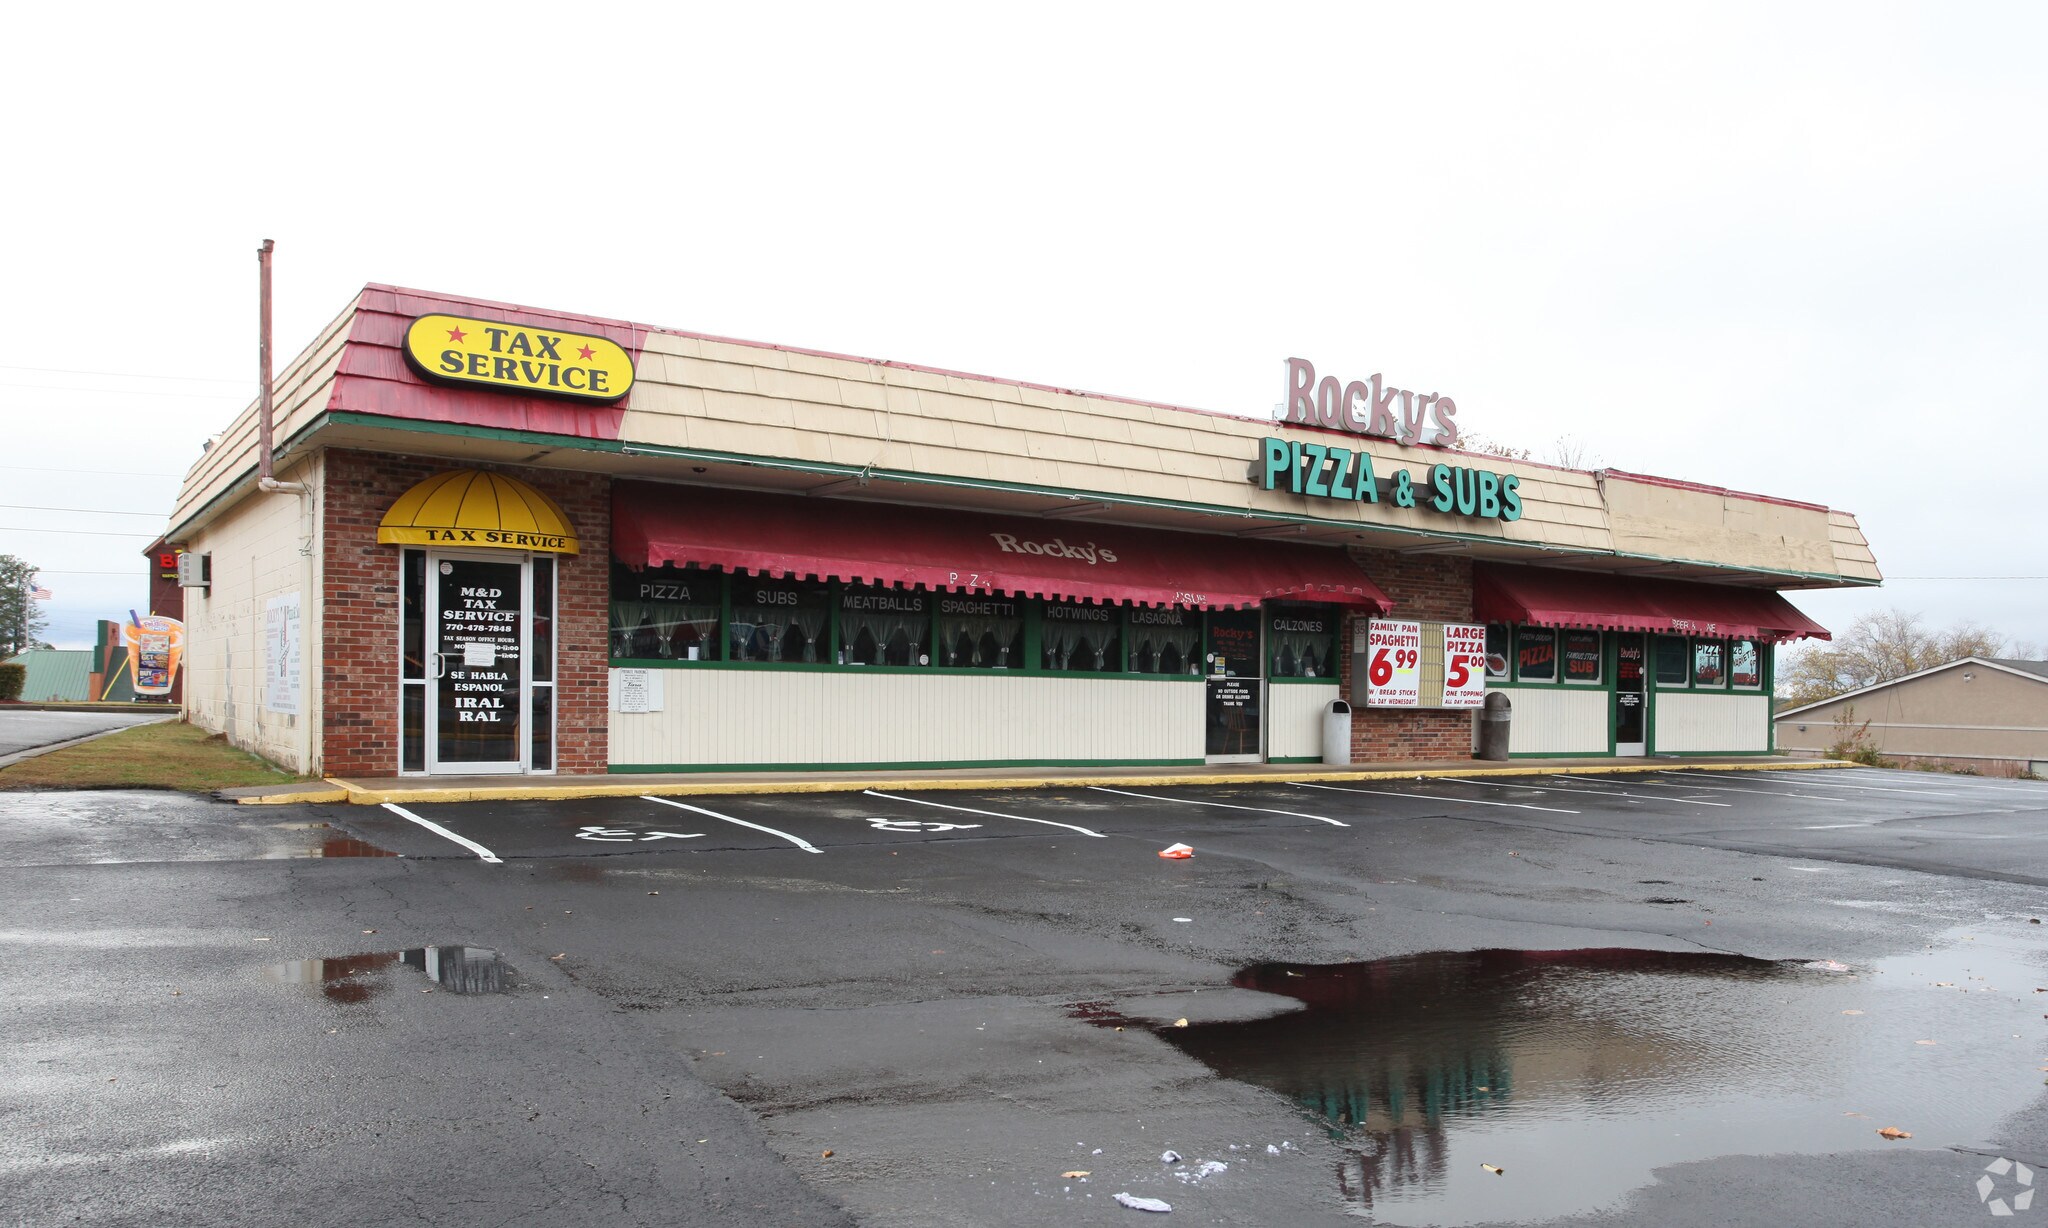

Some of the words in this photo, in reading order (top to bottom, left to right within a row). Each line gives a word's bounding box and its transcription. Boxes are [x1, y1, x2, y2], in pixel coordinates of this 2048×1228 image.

[485, 327, 562, 361] TAX
[439, 350, 610, 393] SERVICE
[1284, 356, 1457, 446] Rocky's
[1261, 436, 1379, 503] PIZZA
[1394, 468, 1416, 509] &
[1430, 463, 1522, 522] SUBS
[425, 530, 476, 542] TAX
[485, 531, 566, 549] SERVICE
[990, 532, 1118, 565] Rocky's
[460, 587, 502, 598] M&D
[640, 583, 691, 600] PIZZA
[756, 590, 798, 605] SUBS
[463, 599, 497, 609] TAX
[843, 595, 922, 612] MEATBALLS
[941, 600, 1015, 616] SPAGHETTI
[443, 610, 515, 622] SERVICE
[1047, 606, 1109, 622] HOTWINGS
[1132, 612, 1183, 626] LASAGNA
[445, 624, 512, 633] 770-478-7848
[1273, 619, 1323, 632] CALZONES
[1370, 622, 1398, 632] FAMILY
[1401, 624, 1418, 633] PAN
[1446, 626, 1485, 640] LARGE
[1369, 633, 1419, 648] SPAGHETTI
[1446, 641, 1484, 653] PIZZA
[1519, 644, 1554, 669] PIZZA
[1566, 651, 1584, 659] FAMOUS
[1583, 652, 1599, 661] STEAK
[1569, 660, 1595, 673] SUB
[450, 671, 465, 680] SE
[471, 672, 508, 680] HABLA
[454, 683, 505, 692] ESPANOL
[455, 697, 504, 709] IRAL
[459, 711, 501, 722] RAL
